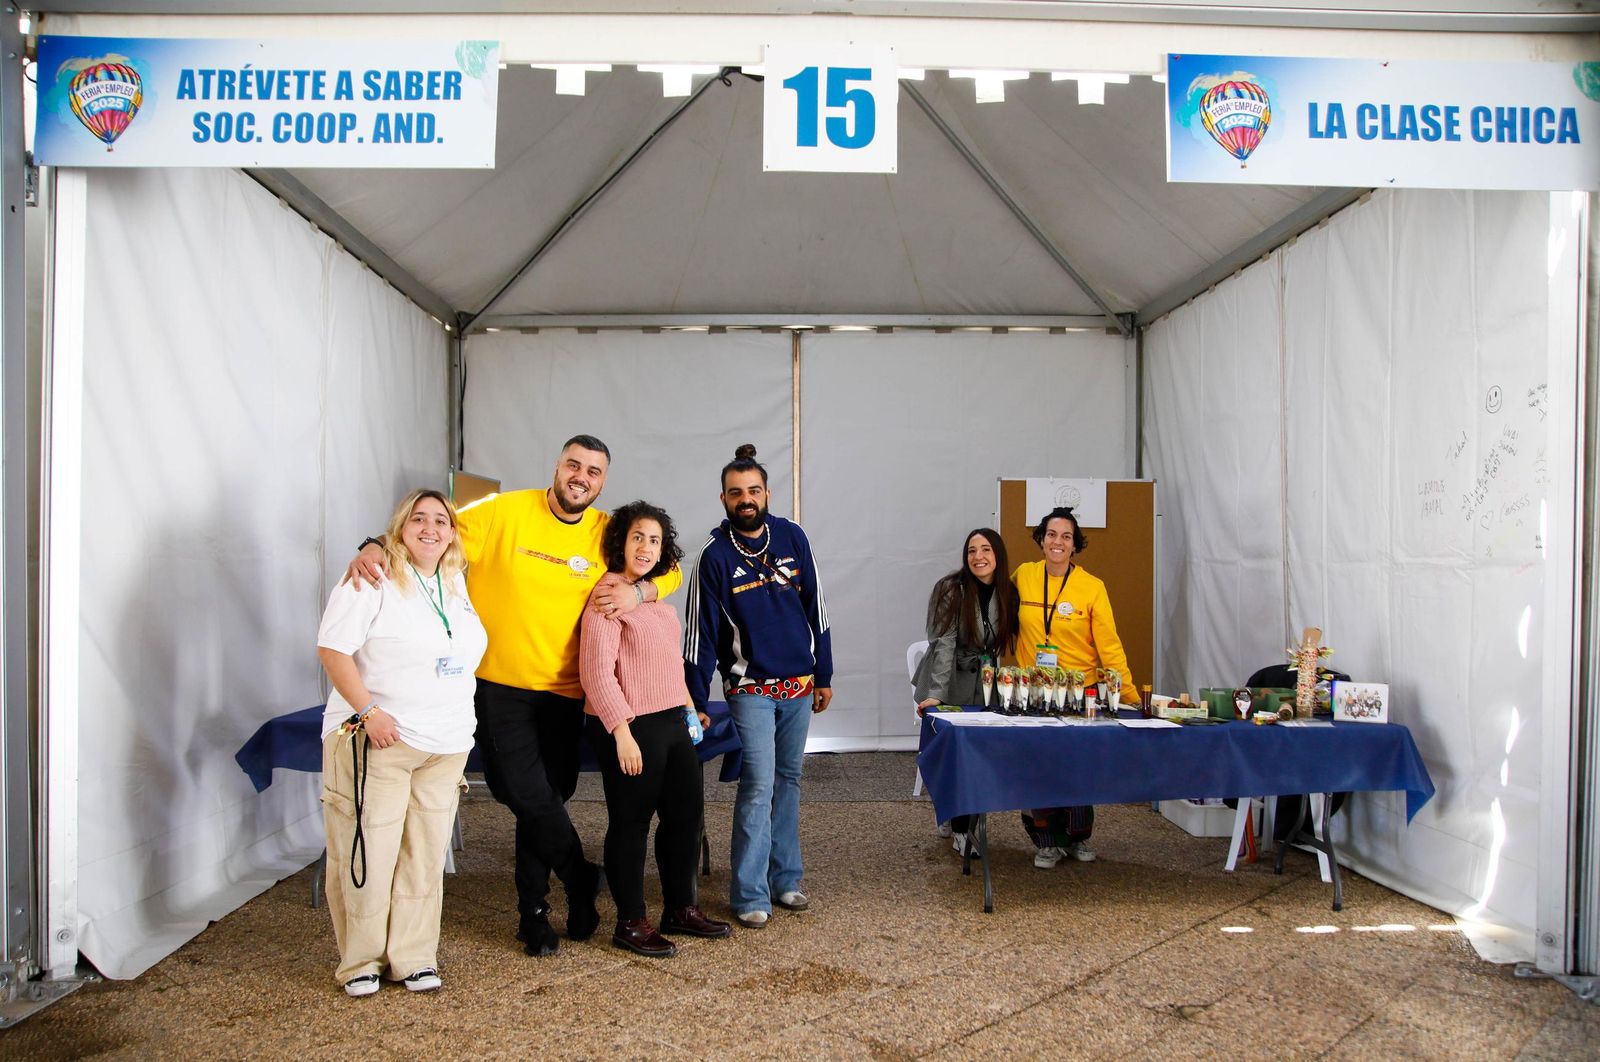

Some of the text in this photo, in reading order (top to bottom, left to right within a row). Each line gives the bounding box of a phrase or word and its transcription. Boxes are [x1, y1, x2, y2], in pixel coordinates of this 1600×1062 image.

[80, 83, 135, 101] FERIA EMPLEO
[176, 63, 463, 101] ATRÉVETE A SABER
[91, 97, 125, 112] 2025
[782, 66, 876, 149] 15
[1211, 101, 1263, 118] FERIA EMPLEO
[192, 111, 444, 144] SOC. COOP. AND.
[1224, 115, 1254, 129] 2025
[1308, 102, 1582, 145] LA CLASE CHICA
